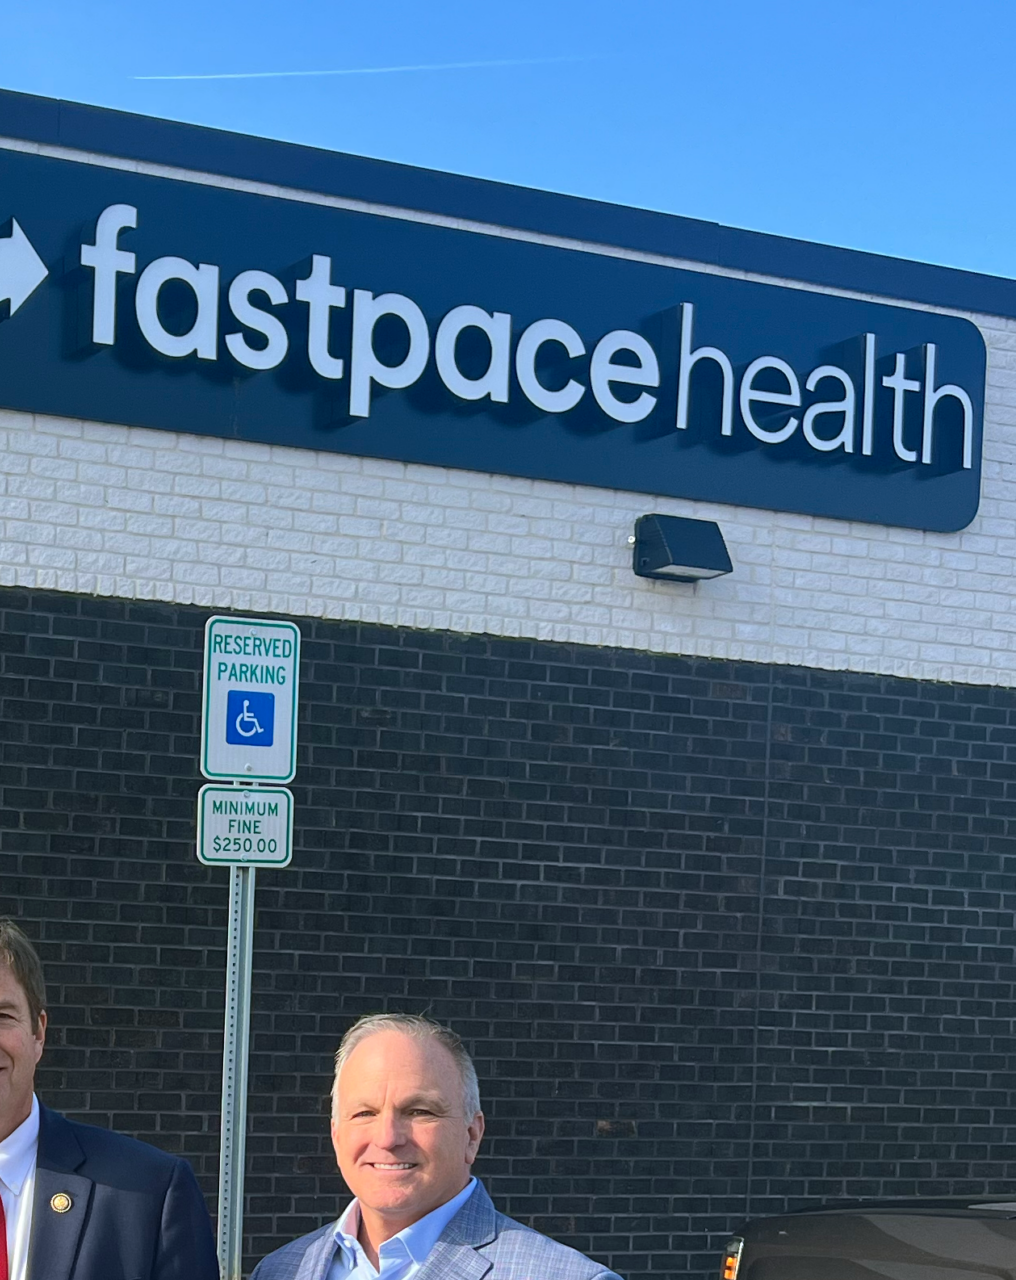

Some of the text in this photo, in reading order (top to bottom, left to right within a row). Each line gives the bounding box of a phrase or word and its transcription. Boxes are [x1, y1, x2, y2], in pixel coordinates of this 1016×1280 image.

[213, 634, 292, 658] RESERVED
[218, 662, 286, 685] PARKING
[213, 800, 278, 816] MINIMUM
[228, 819, 262, 834] FINE
[213, 835, 277, 853] $250.00
